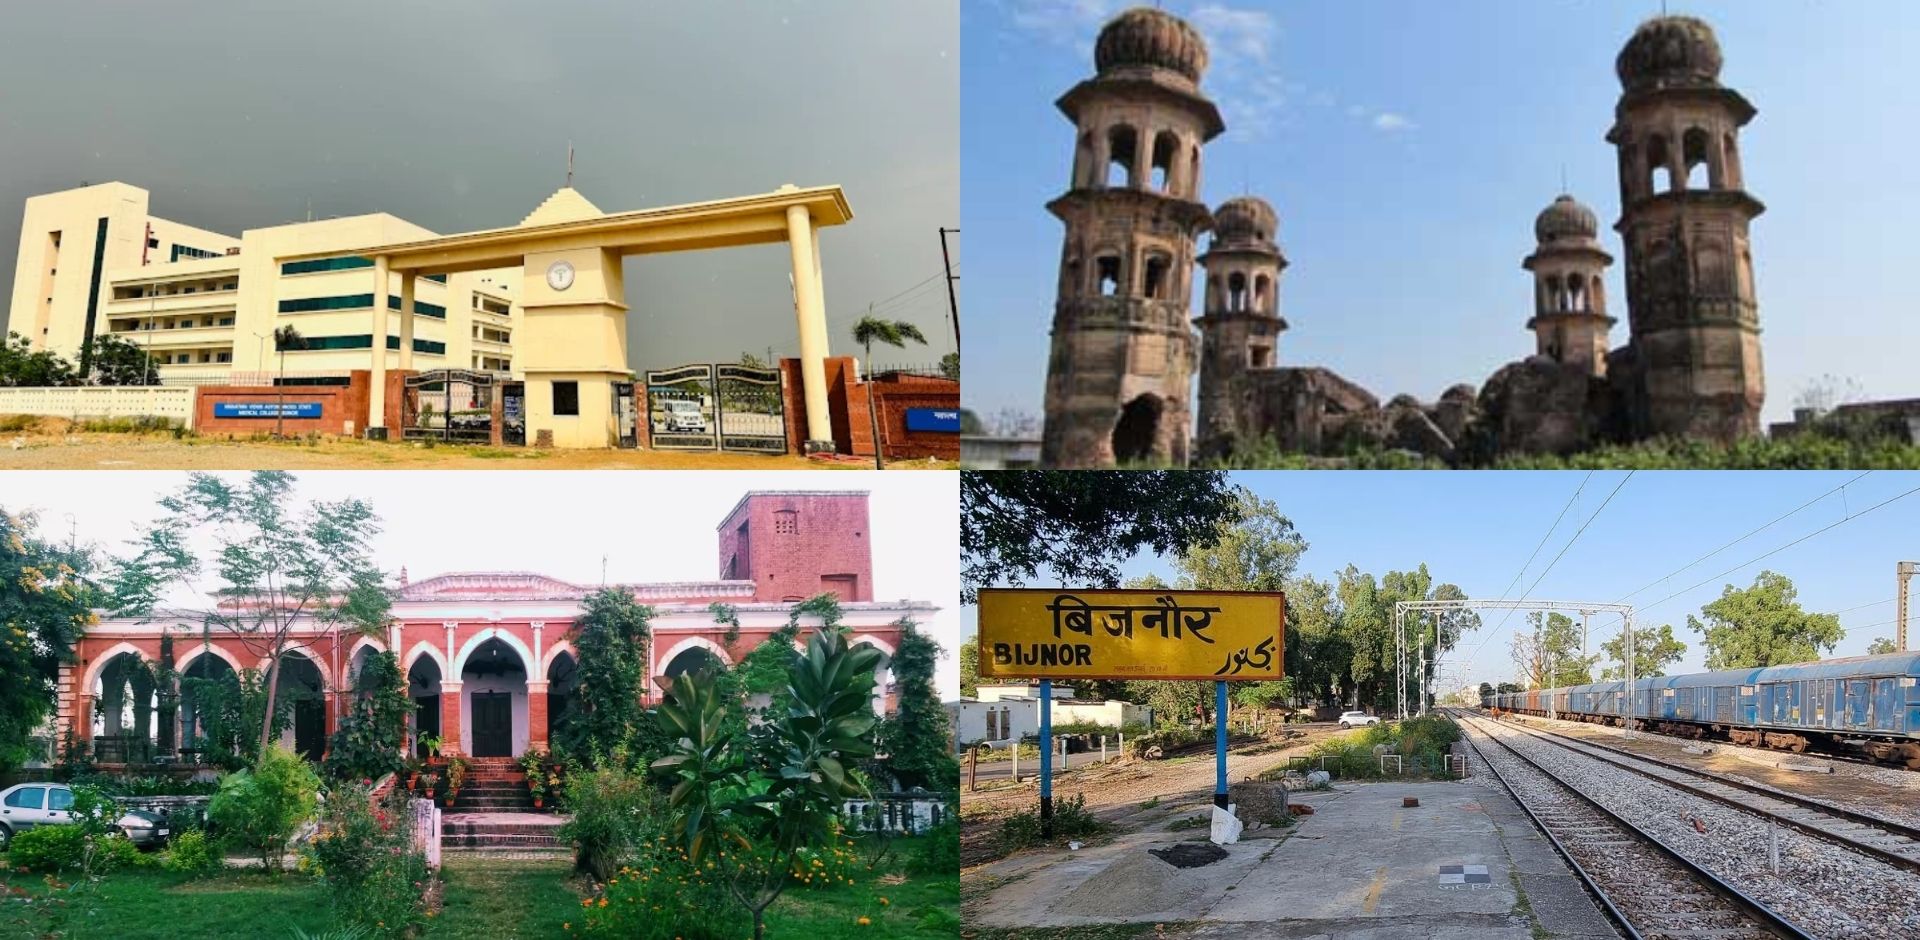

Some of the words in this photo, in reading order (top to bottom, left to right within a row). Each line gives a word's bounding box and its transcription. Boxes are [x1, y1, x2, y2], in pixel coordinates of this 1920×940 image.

[1046, 594, 1222, 644] बिजनौर
[994, 643, 1092, 666] BIJNOR
[1214, 636, 1276, 675] بجنور
